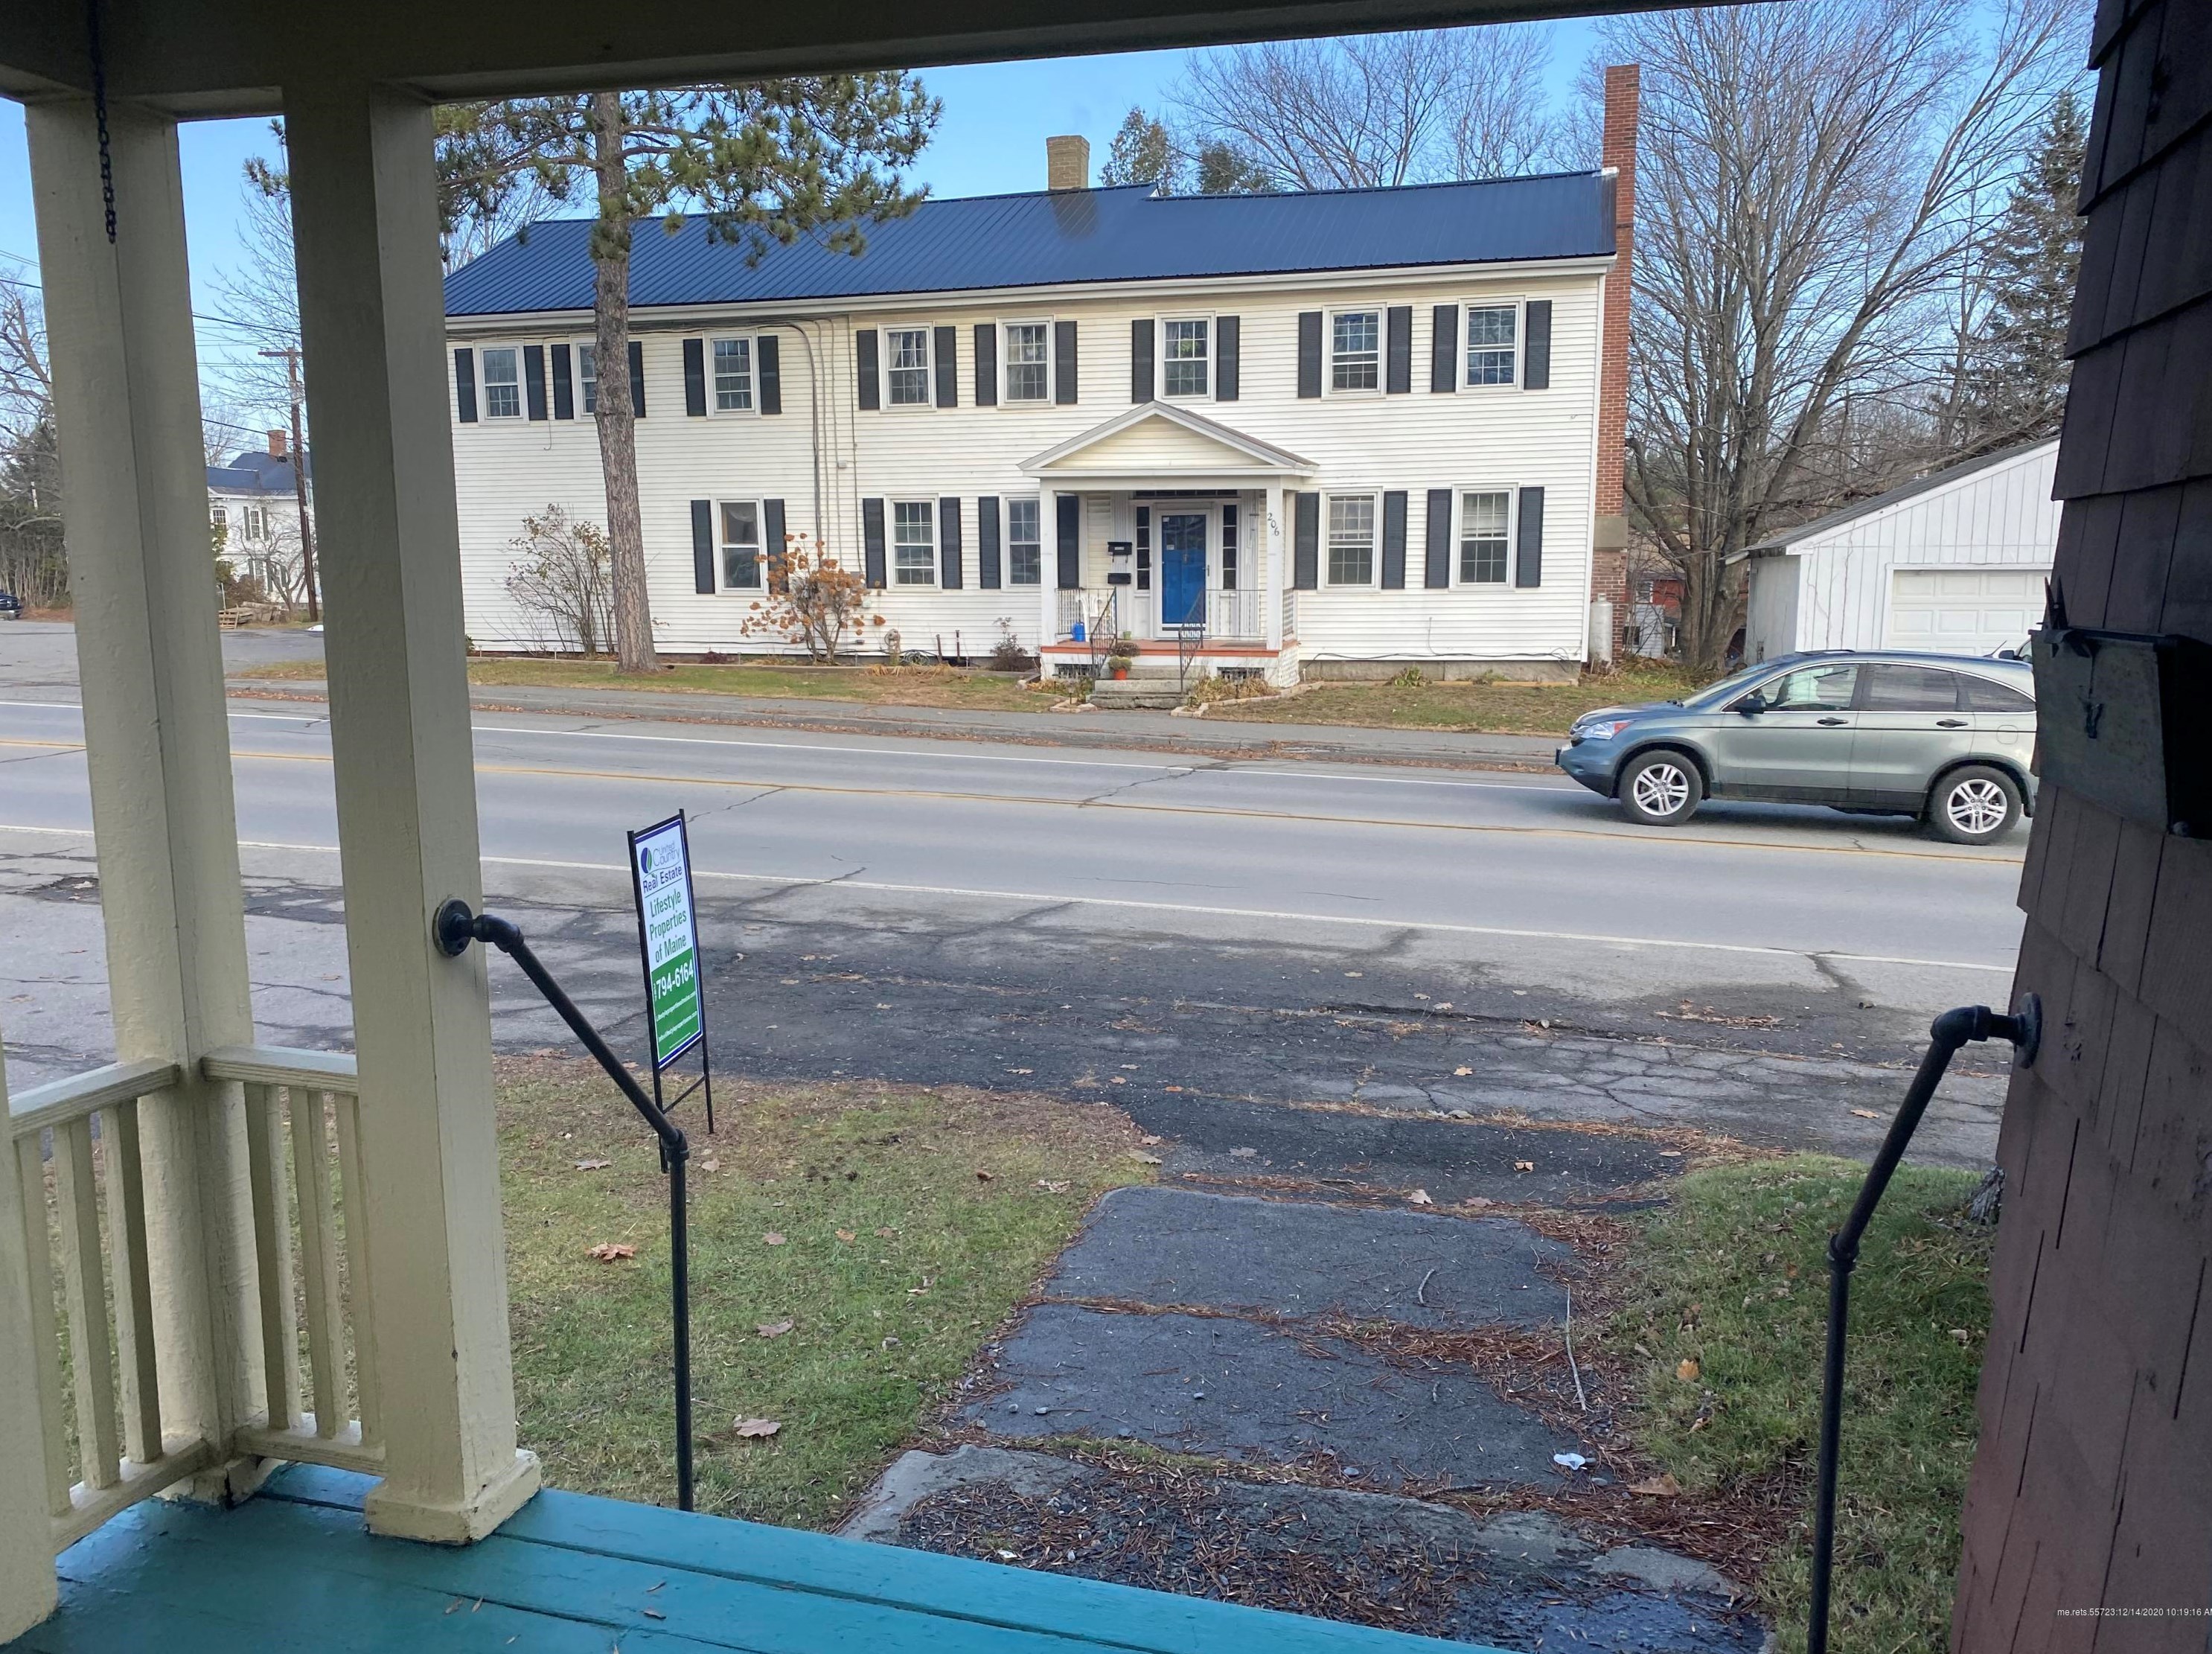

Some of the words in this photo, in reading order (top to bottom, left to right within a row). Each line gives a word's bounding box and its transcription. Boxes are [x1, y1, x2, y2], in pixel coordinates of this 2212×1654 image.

[1268, 513, 1279, 536] 206
[653, 848, 680, 866] Country
[659, 840, 675, 856] United
[643, 875, 658, 893] Real
[659, 866, 683, 885] Estate
[650, 888, 682, 919] Lifestyle
[649, 910, 687, 942] Properties
[655, 943, 662, 963] of
[664, 934, 687, 958] Maine
[656, 958, 694, 1000] 794-6164
